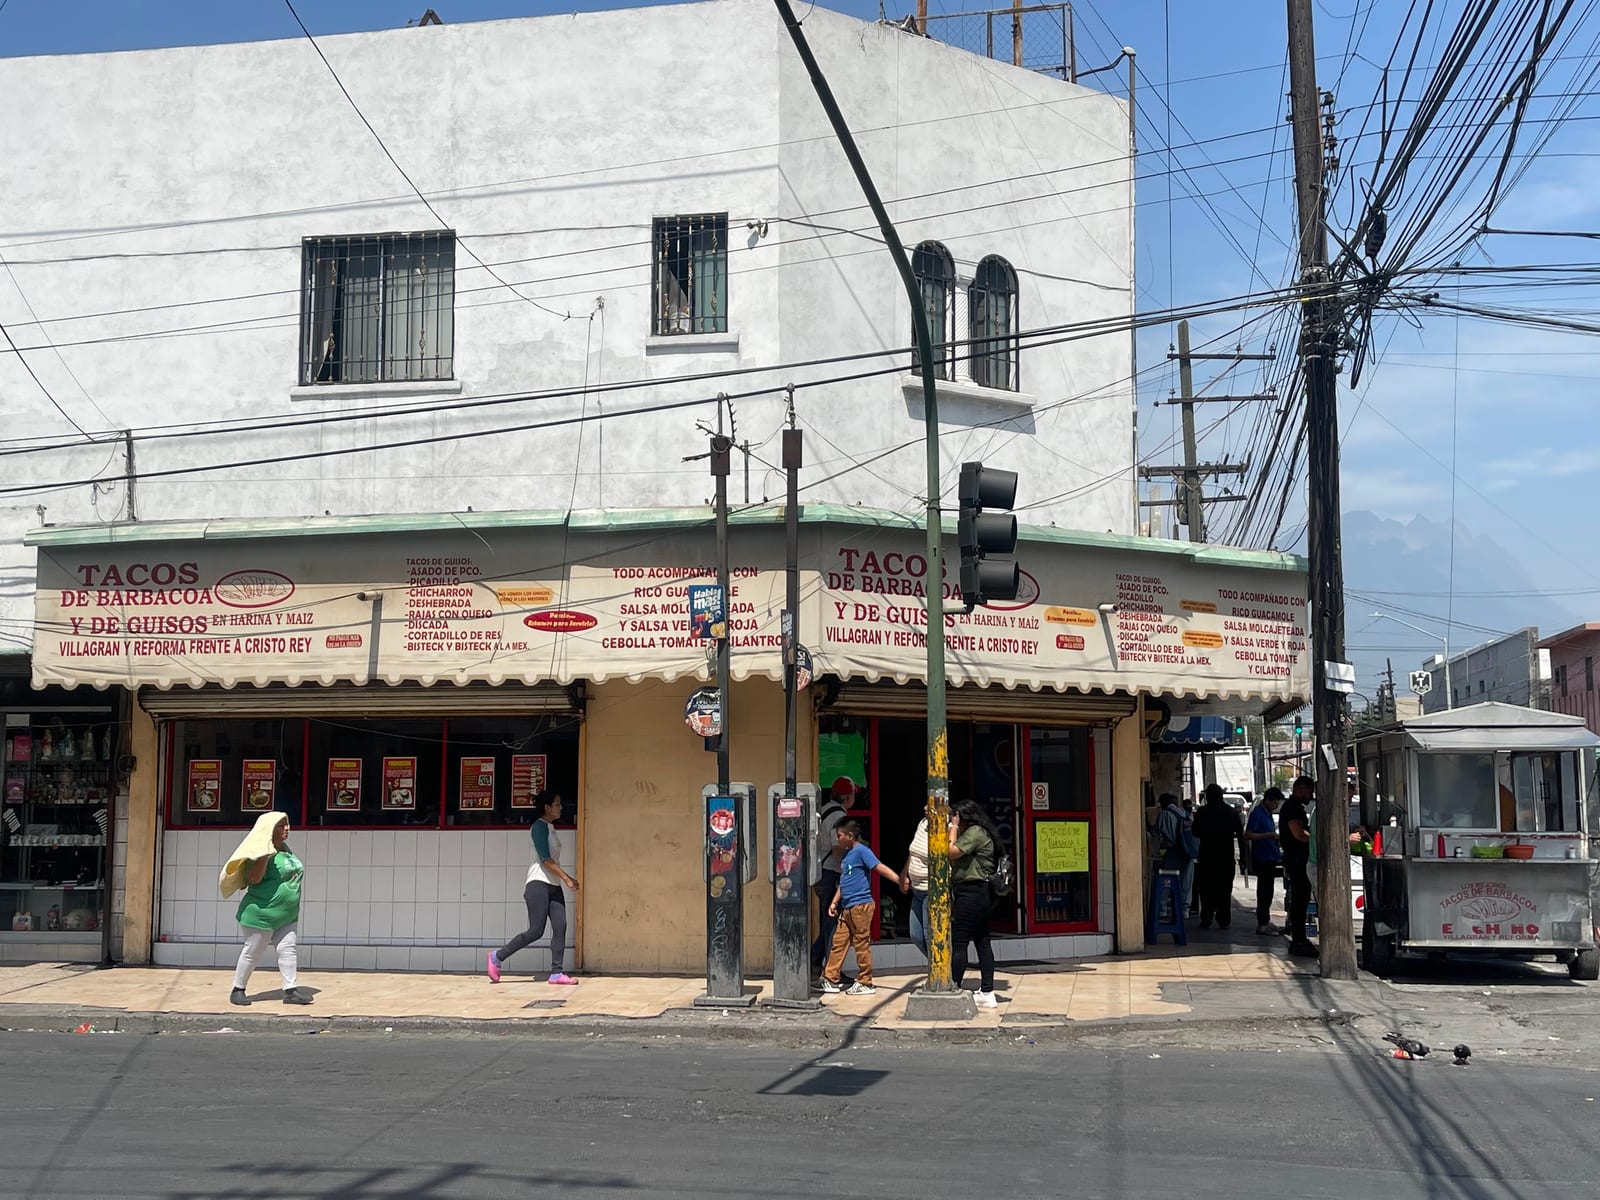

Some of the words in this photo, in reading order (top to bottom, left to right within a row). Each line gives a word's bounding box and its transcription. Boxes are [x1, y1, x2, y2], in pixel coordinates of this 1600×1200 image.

[78, 563, 200, 587] TACOS
[443, 567, 458, 576] DE
[460, 567, 482, 576] PCO.
[613, 568, 645, 579] TODO
[648, 566, 730, 578] ACOMPAÑA
[734, 567, 758, 578] CON
[1116, 574, 1132, 583] TACOS
[634, 586, 662, 598] RICO
[828, 572, 855, 591] DE
[861, 575, 964, 600] BARBAOA
[1143, 584, 1152, 593] DE
[1152, 586, 1168, 596] PCO.
[60, 590, 90, 608] DE
[96, 588, 213, 606] BARBACOA
[694, 588, 718, 599] Habla
[1218, 589, 1238, 600] TODO
[1240, 590, 1288, 605] ACOMPAÑADO
[1290, 596, 1305, 607] CON
[438, 610, 459, 618] CON
[462, 610, 493, 620] QUESO
[620, 604, 658, 615] SALSA
[834, 602, 847, 620] Y
[854, 603, 880, 622] DE
[886, 605, 956, 628] GUISS
[960, 613, 972, 625] EN
[974, 614, 1008, 628] HARINA
[1010, 616, 1016, 628] Y
[1232, 607, 1250, 618] RICO
[1252, 608, 1294, 622] GUACAMOLE
[70, 617, 84, 634] Y
[90, 616, 120, 634] DE
[127, 615, 208, 634] GUISOS
[212, 614, 228, 626] EN
[230, 614, 272, 626] HARINA
[276, 614, 284, 624] Y
[286, 613, 314, 624] MAIZ
[620, 620, 626, 632] Y
[630, 620, 668, 632] SALSA
[728, 619, 758, 630] ROJA
[1141, 624, 1155, 633] CON
[1156, 624, 1178, 635] QUESO
[1224, 621, 1248, 632] SALSA
[1250, 622, 1304, 637] MOLCAJETEADA
[470, 632, 484, 640] DE
[485, 631, 502, 640] RES
[826, 626, 882, 646] VILLAGRAN
[885, 629, 892, 646] Y
[894, 630, 928, 648] REFOR
[944, 636, 976, 652] RENTE
[978, 635, 985, 651] A
[987, 636, 1019, 654] CRISTO
[1022, 638, 1039, 656] REY
[60, 640, 120, 656] VILLAGRAN
[124, 640, 131, 656] Y
[134, 640, 186, 656] REFORMA
[190, 638, 230, 654] FRENTE
[234, 638, 242, 654] A
[245, 638, 286, 654] CRISTO
[289, 637, 312, 654] REY
[446, 642, 454, 651] Y
[454, 642, 492, 650] BISTECK
[512, 642, 530, 650] MEX.
[602, 637, 656, 649] CEBOLLA
[660, 637, 709, 648] TOMATE
[729, 636, 782, 648] ILANTRO
[1224, 636, 1230, 646] Y
[1231, 636, 1254, 648] SALSA
[1256, 638, 1279, 649] VERDE
[1281, 640, 1286, 650] Y
[1288, 640, 1306, 651] ROJA
[1164, 645, 1172, 654] DE
[1174, 646, 1184, 654] RES
[1148, 654, 1152, 663] Y
[1154, 654, 1179, 664] BISTECK
[1180, 656, 1186, 664] A
[1186, 656, 1196, 665] LA
[1196, 656, 1212, 666] MEX.
[1235, 651, 1268, 662] CEBOLLA
[1270, 652, 1298, 664] TOMATE
[1248, 664, 1254, 674] Y
[1255, 665, 1290, 676] CILANTRO
[1040, 827, 1048, 842] 5
[1440, 890, 1468, 910] TACOS
[1471, 888, 1483, 896] DE
[1486, 888, 1538, 912] BARBACOA
